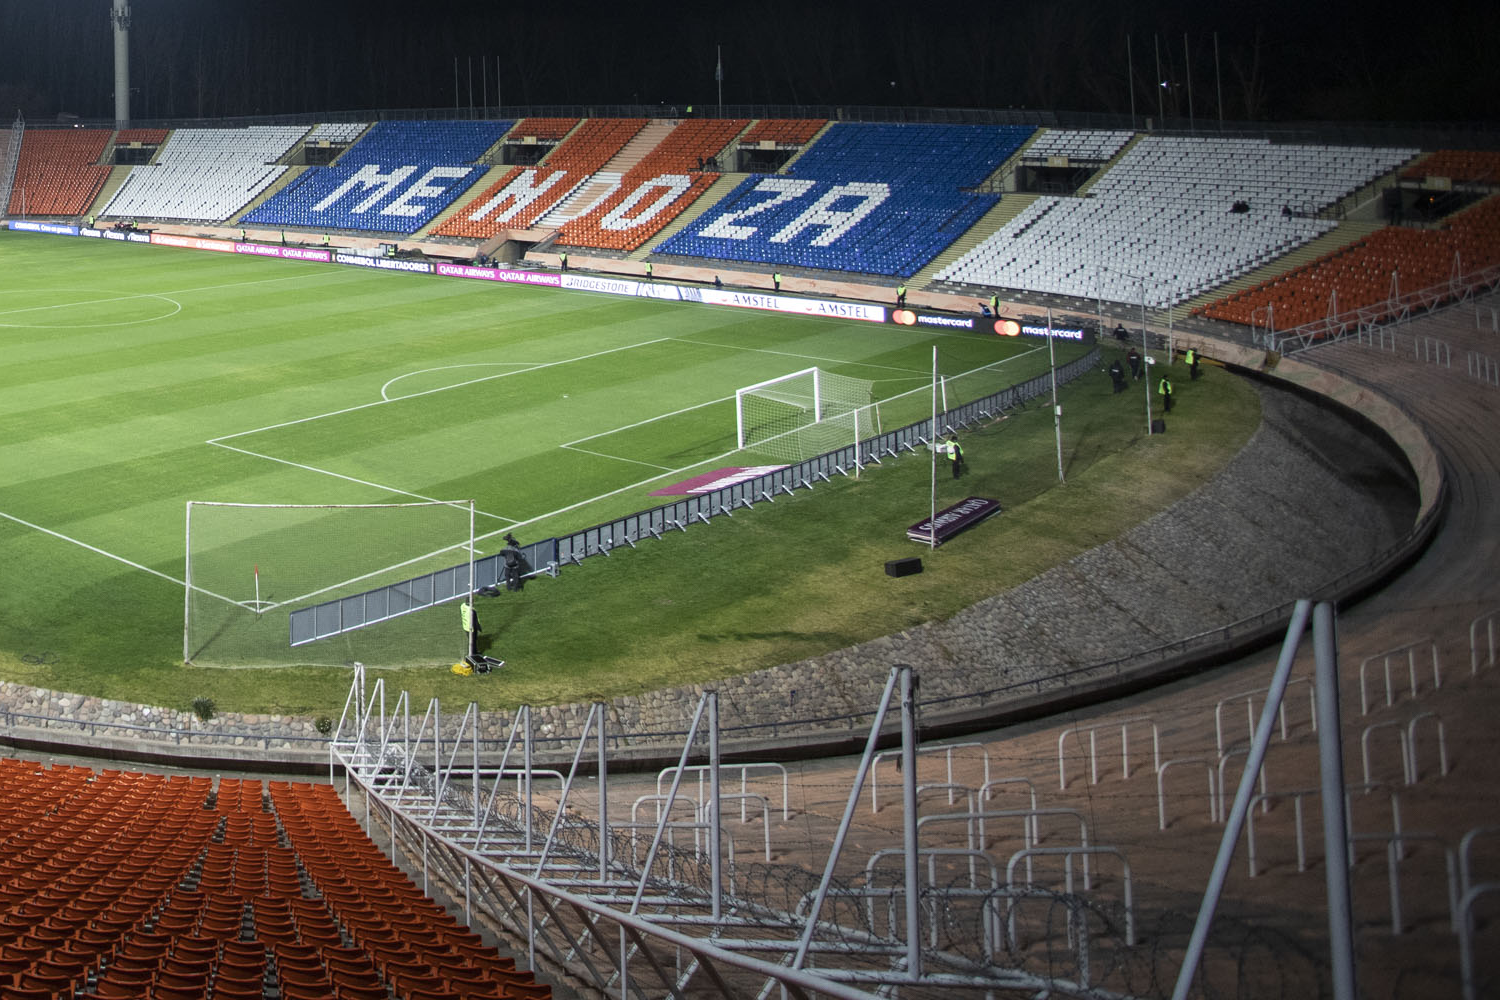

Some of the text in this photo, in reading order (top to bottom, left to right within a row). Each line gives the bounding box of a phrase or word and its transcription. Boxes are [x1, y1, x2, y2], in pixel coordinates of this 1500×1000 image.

[236, 245, 279, 256] QATAR AIRWAYS
[282, 249, 328, 261] QATAR AIRWAYS
[336, 254, 429, 273] CONMEBOL LIBERTADORES
[439, 265, 494, 279] QATAR AIRWAYS
[499, 272, 560, 285] QATAR AIRWAYS
[566, 278, 629, 293] BRIDGESTONE
[733, 294, 780, 309] AMSTEL
[818, 303, 868, 318] AMSTEL
[918, 314, 974, 328] mastercard
[1022, 326, 1084, 339] mastercard
